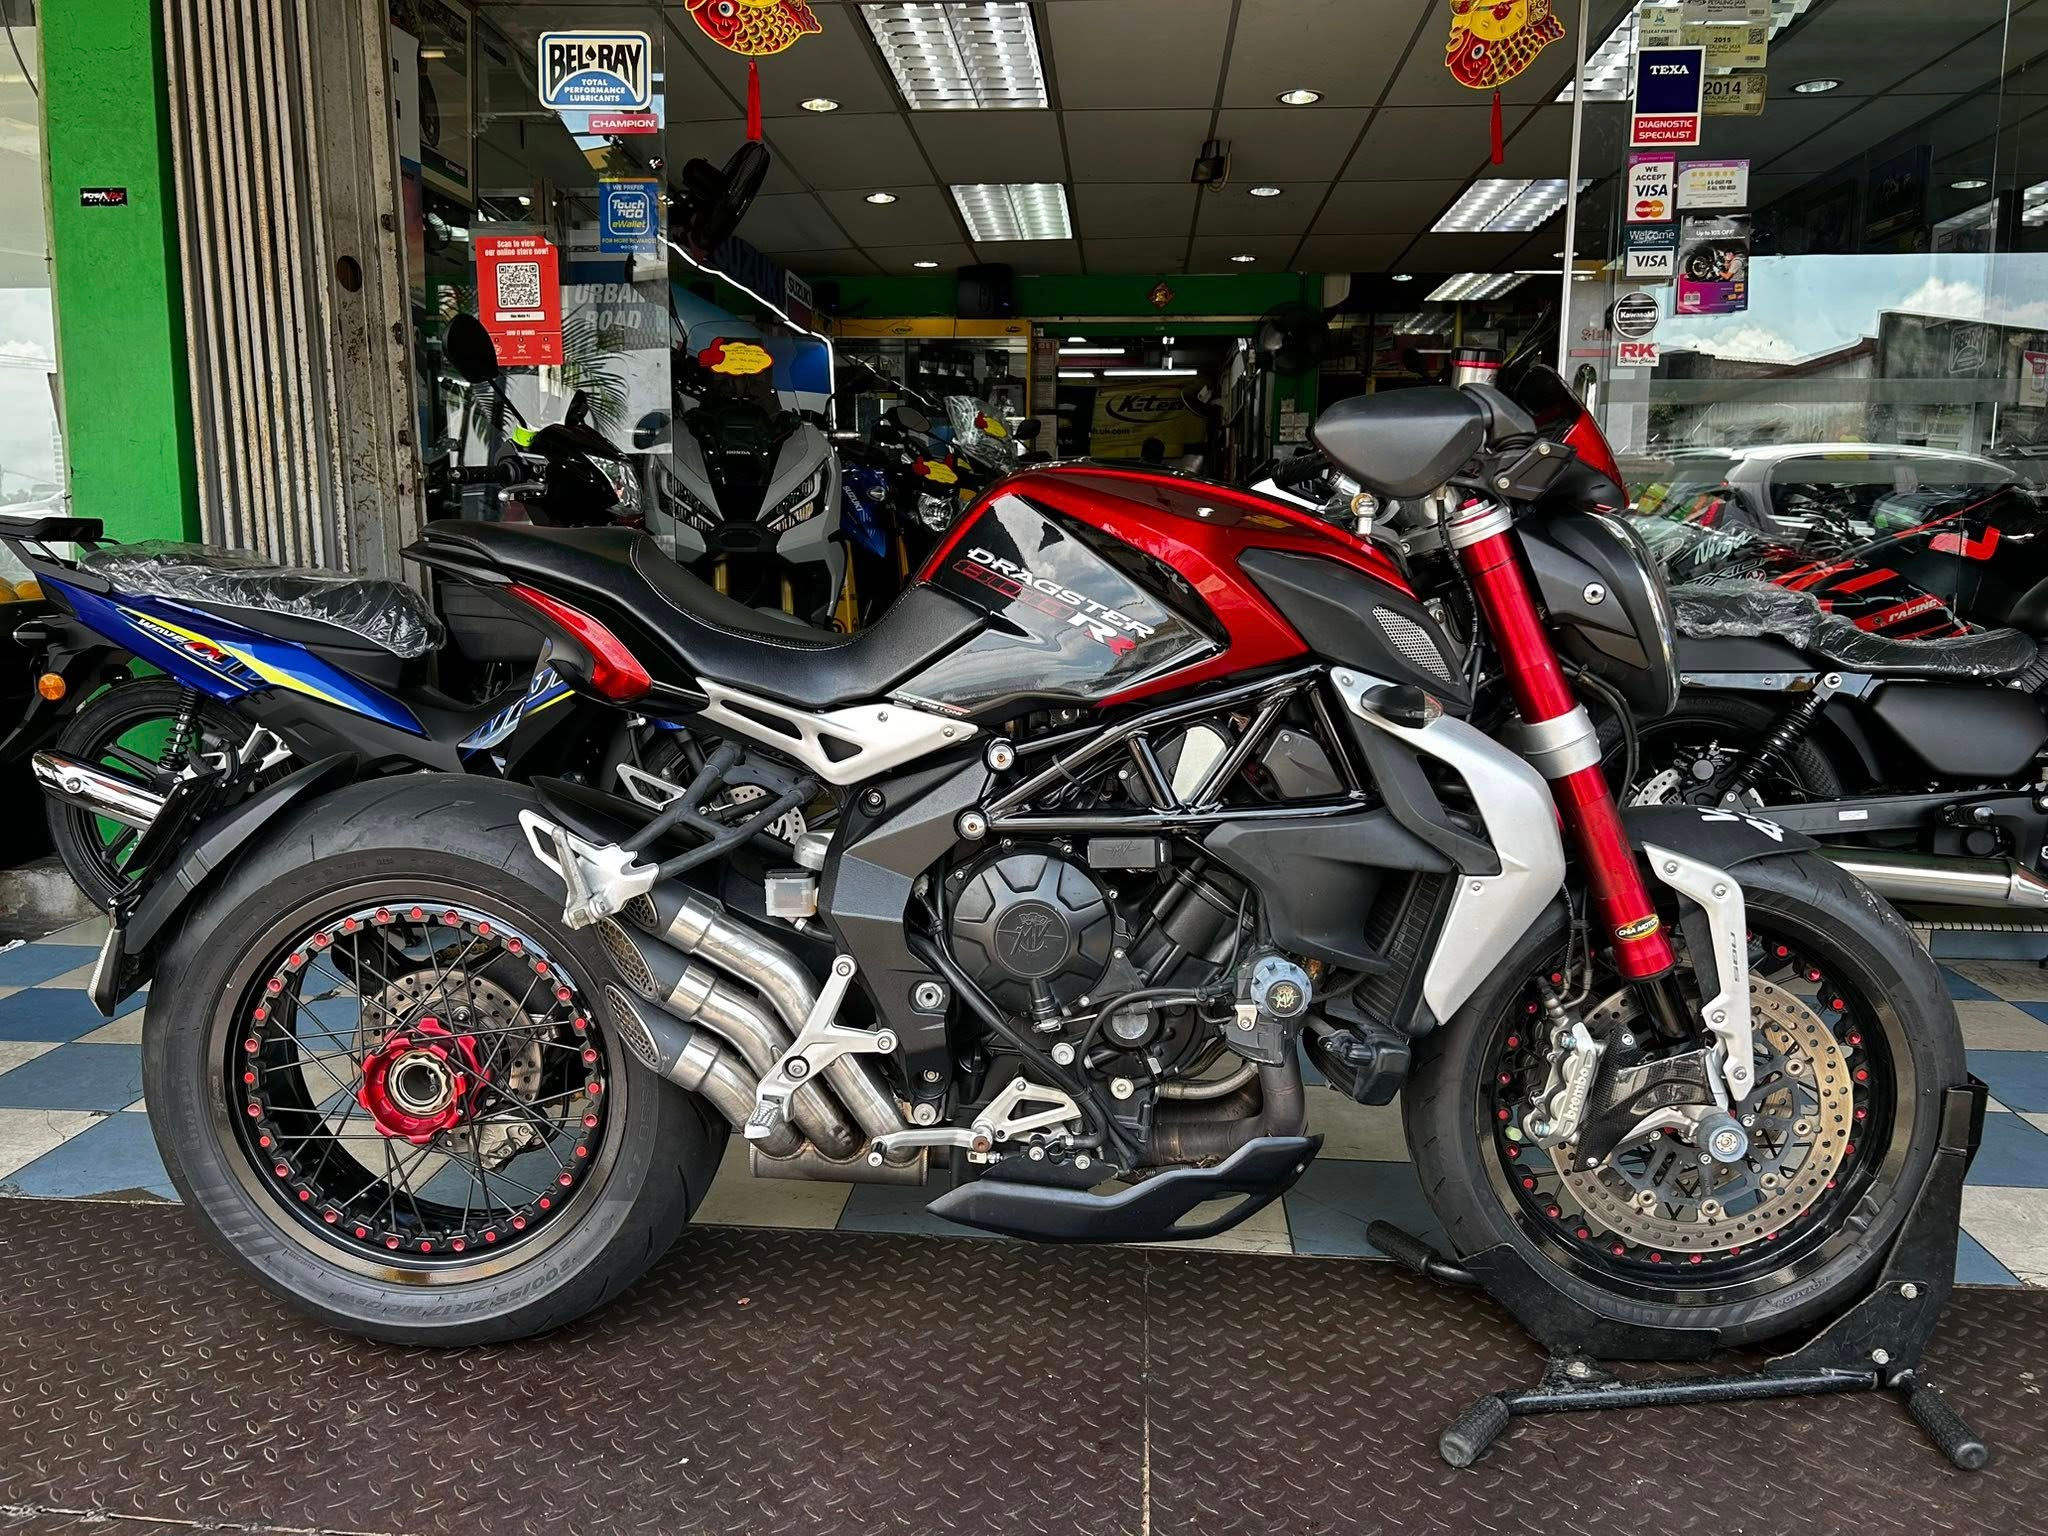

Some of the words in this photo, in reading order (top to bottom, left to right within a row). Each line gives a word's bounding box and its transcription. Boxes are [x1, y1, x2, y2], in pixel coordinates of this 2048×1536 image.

[1649, 64, 1690, 76] TEXA
[564, 86, 626, 94] PERFORMANCE
[1703, 81, 1742, 95] 2014
[569, 94, 621, 102] LUBRICANTS
[591, 120, 656, 129] CHAMPION
[1638, 119, 1694, 129] DIAGNOSTIC
[1638, 130, 1692, 140] SPECIALIST
[623, 183, 645, 191] PREFER
[1633, 184, 1668, 197] VISA
[611, 199, 645, 210] Touch
[611, 220, 647, 228] eWallet
[1629, 229, 1675, 241] Welcome
[497, 240, 512, 248] Scan
[496, 248, 515, 256] online
[516, 247, 533, 255] store
[1633, 254, 1668, 267] VISA
[1620, 311, 1655, 319] Kawasaki
[585, 310, 642, 332] ROAD
[1620, 343, 1656, 358] RK
[842, 485, 865, 513] SUZUKI
[1694, 527, 1753, 566] Ninja
[966, 546, 1156, 640] DRAGSTER
[1562, 1065, 1590, 1121] brembo
